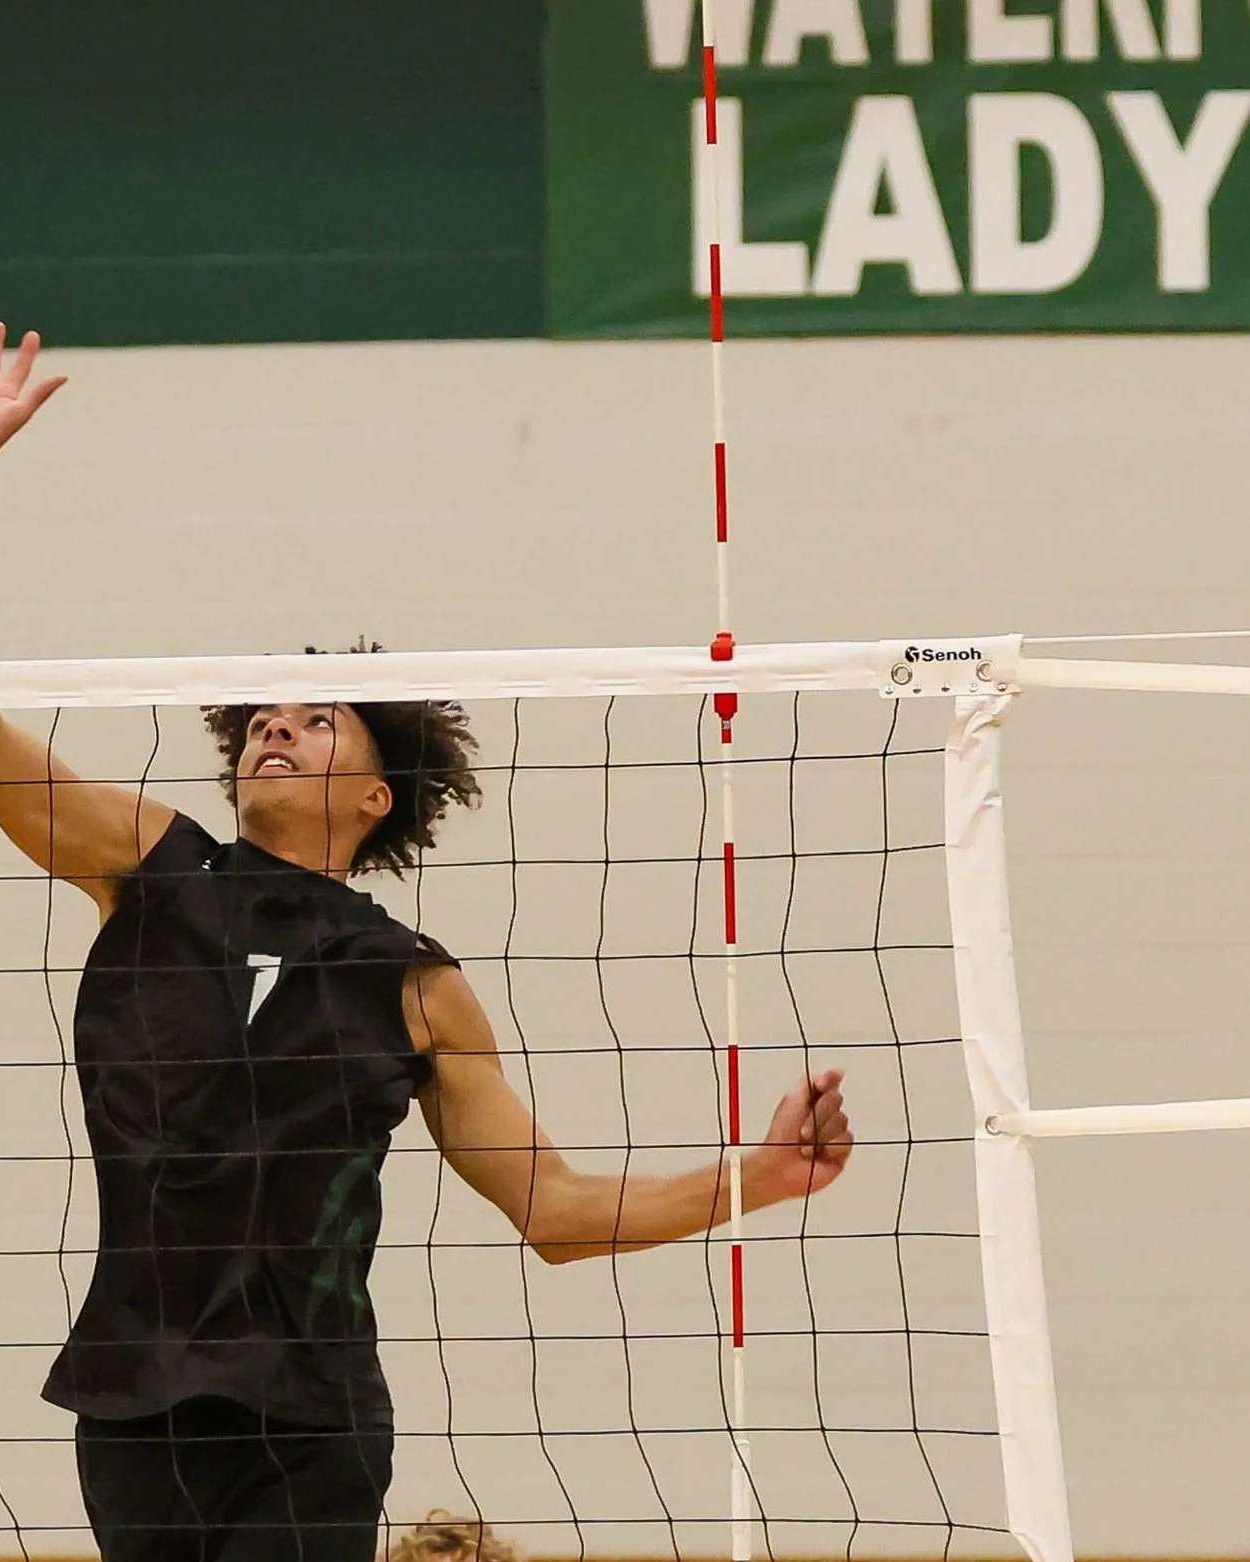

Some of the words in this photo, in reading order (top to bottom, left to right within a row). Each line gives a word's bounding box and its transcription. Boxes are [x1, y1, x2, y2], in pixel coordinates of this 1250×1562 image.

[691, 90, 1250, 297] LADY
[922, 648, 982, 662] Senoh
[246, 953, 283, 1026] 7
